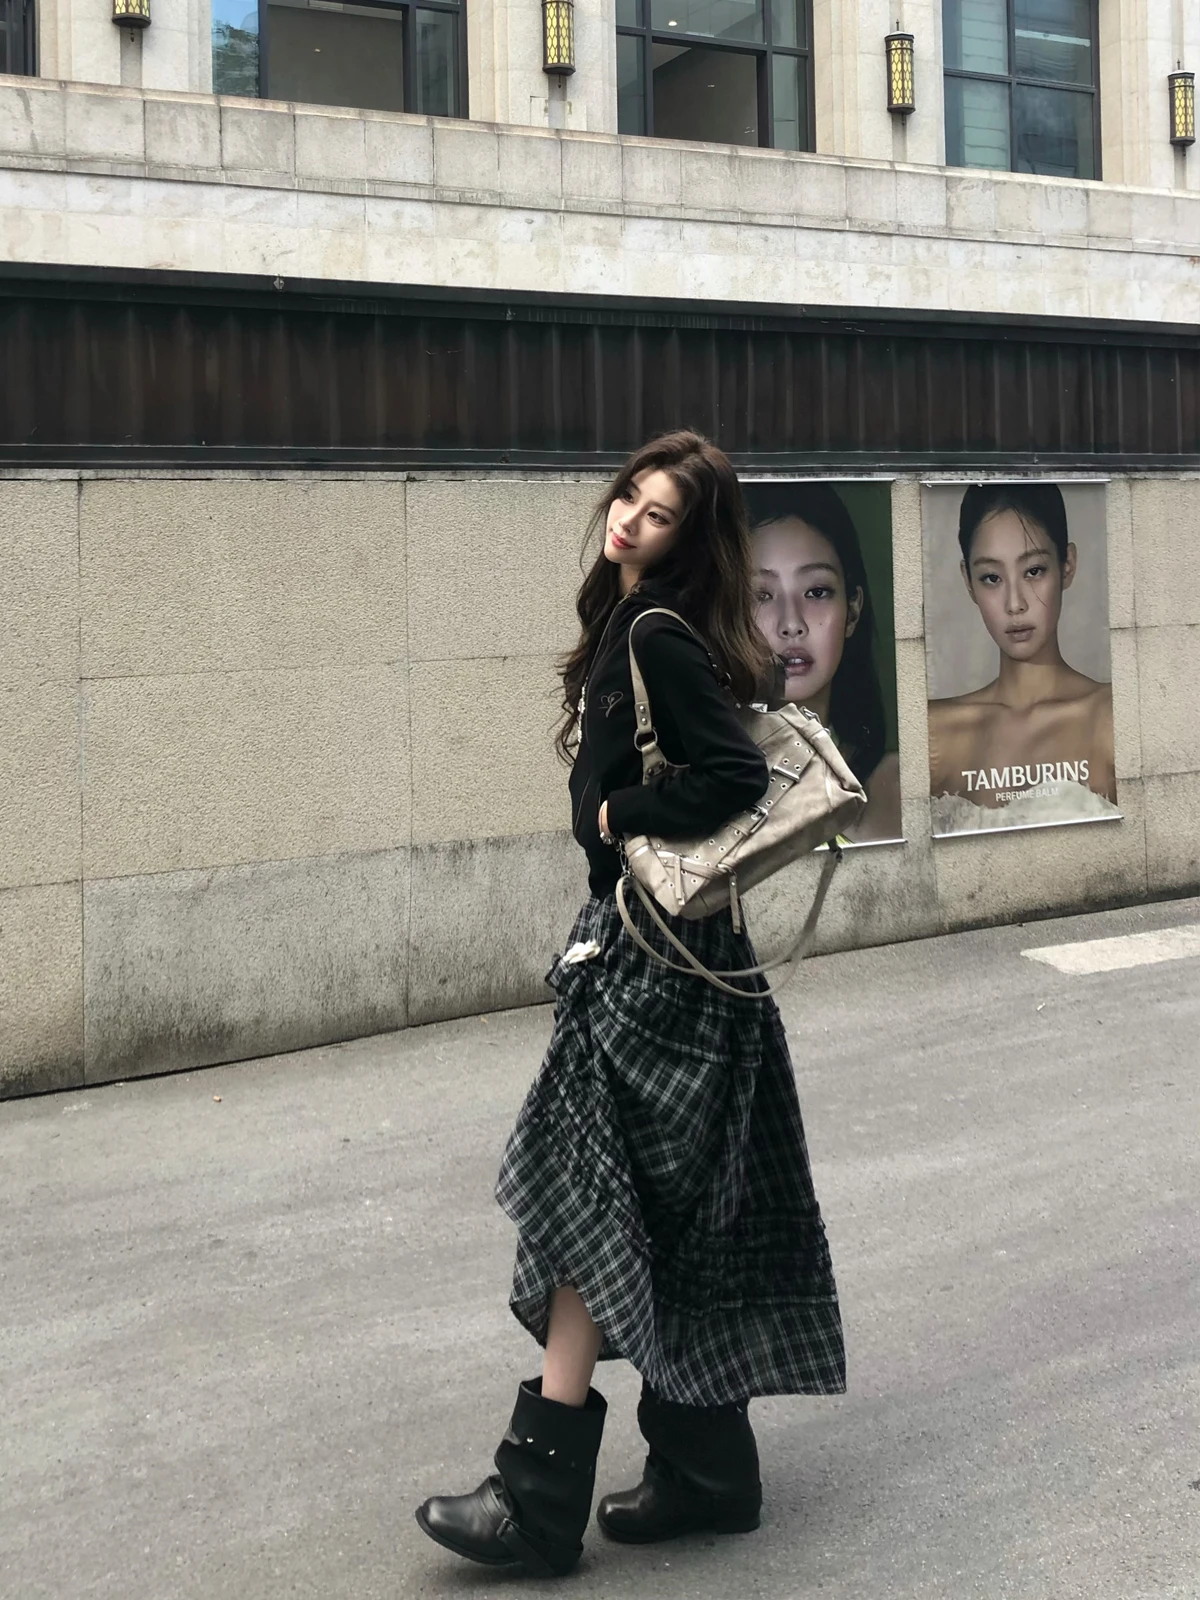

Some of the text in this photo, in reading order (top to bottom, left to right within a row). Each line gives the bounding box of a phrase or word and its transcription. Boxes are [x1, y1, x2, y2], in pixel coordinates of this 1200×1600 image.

[961, 759, 1089, 792] TAMBURINS
[995, 787, 1059, 802] PERFUME BALM
